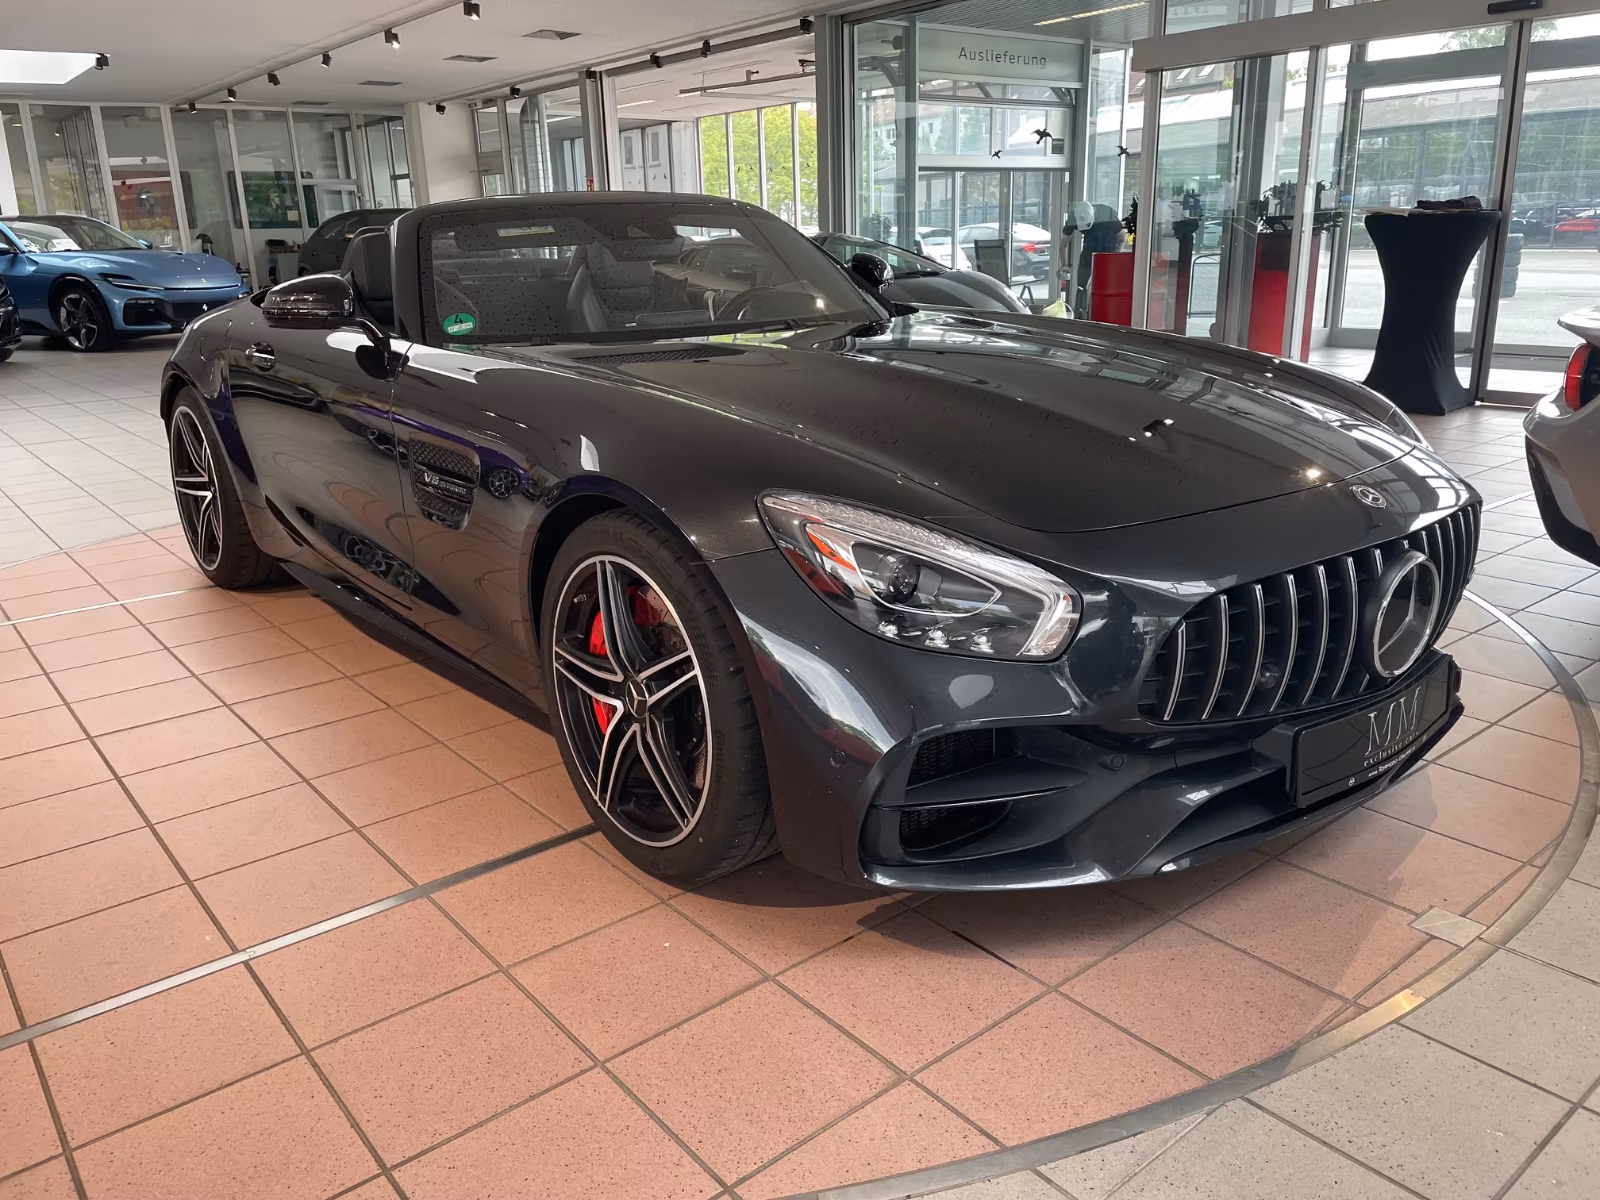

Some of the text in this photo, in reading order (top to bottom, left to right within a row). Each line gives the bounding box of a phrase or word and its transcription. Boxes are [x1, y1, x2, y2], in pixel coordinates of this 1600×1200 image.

[958, 46, 1047, 69] Auslieferung
[453, 314, 465, 324] 4
[1364, 686, 1421, 756] MM
